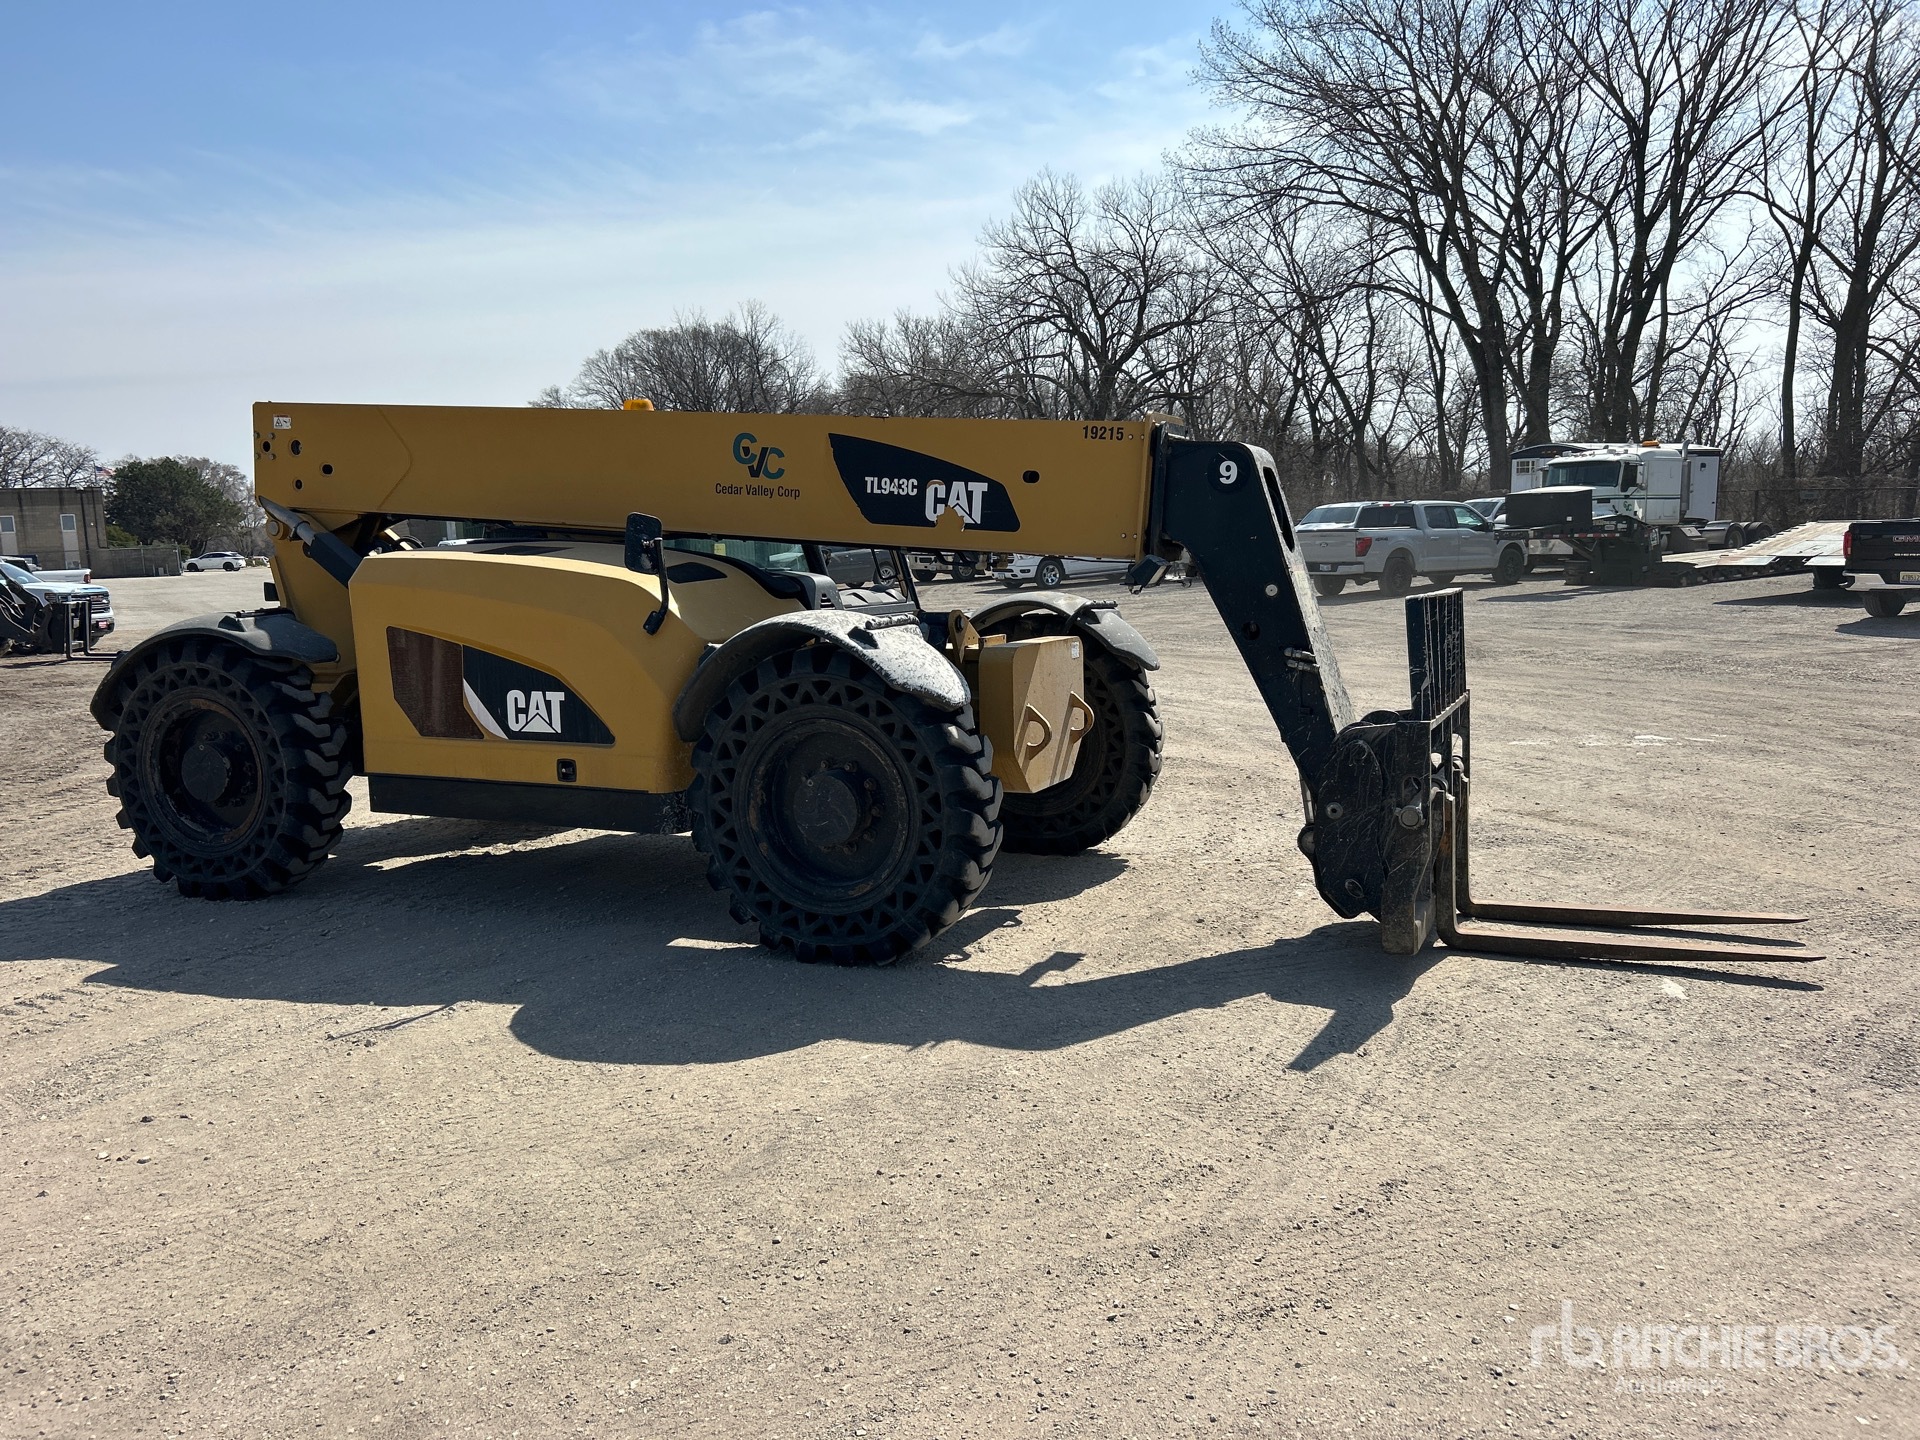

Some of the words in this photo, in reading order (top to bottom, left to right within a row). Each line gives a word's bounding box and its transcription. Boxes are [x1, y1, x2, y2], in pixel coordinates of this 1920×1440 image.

[1083, 425, 1124, 440] 19215
[733, 432, 785, 479] CVC
[1219, 460, 1238, 484] 9
[715, 482, 743, 496] Cedar
[745, 484, 775, 499] Valley
[777, 485, 801, 500] Corp
[865, 476, 918, 496] TL943C
[925, 479, 988, 525] CAT
[506, 689, 565, 734] CAT
